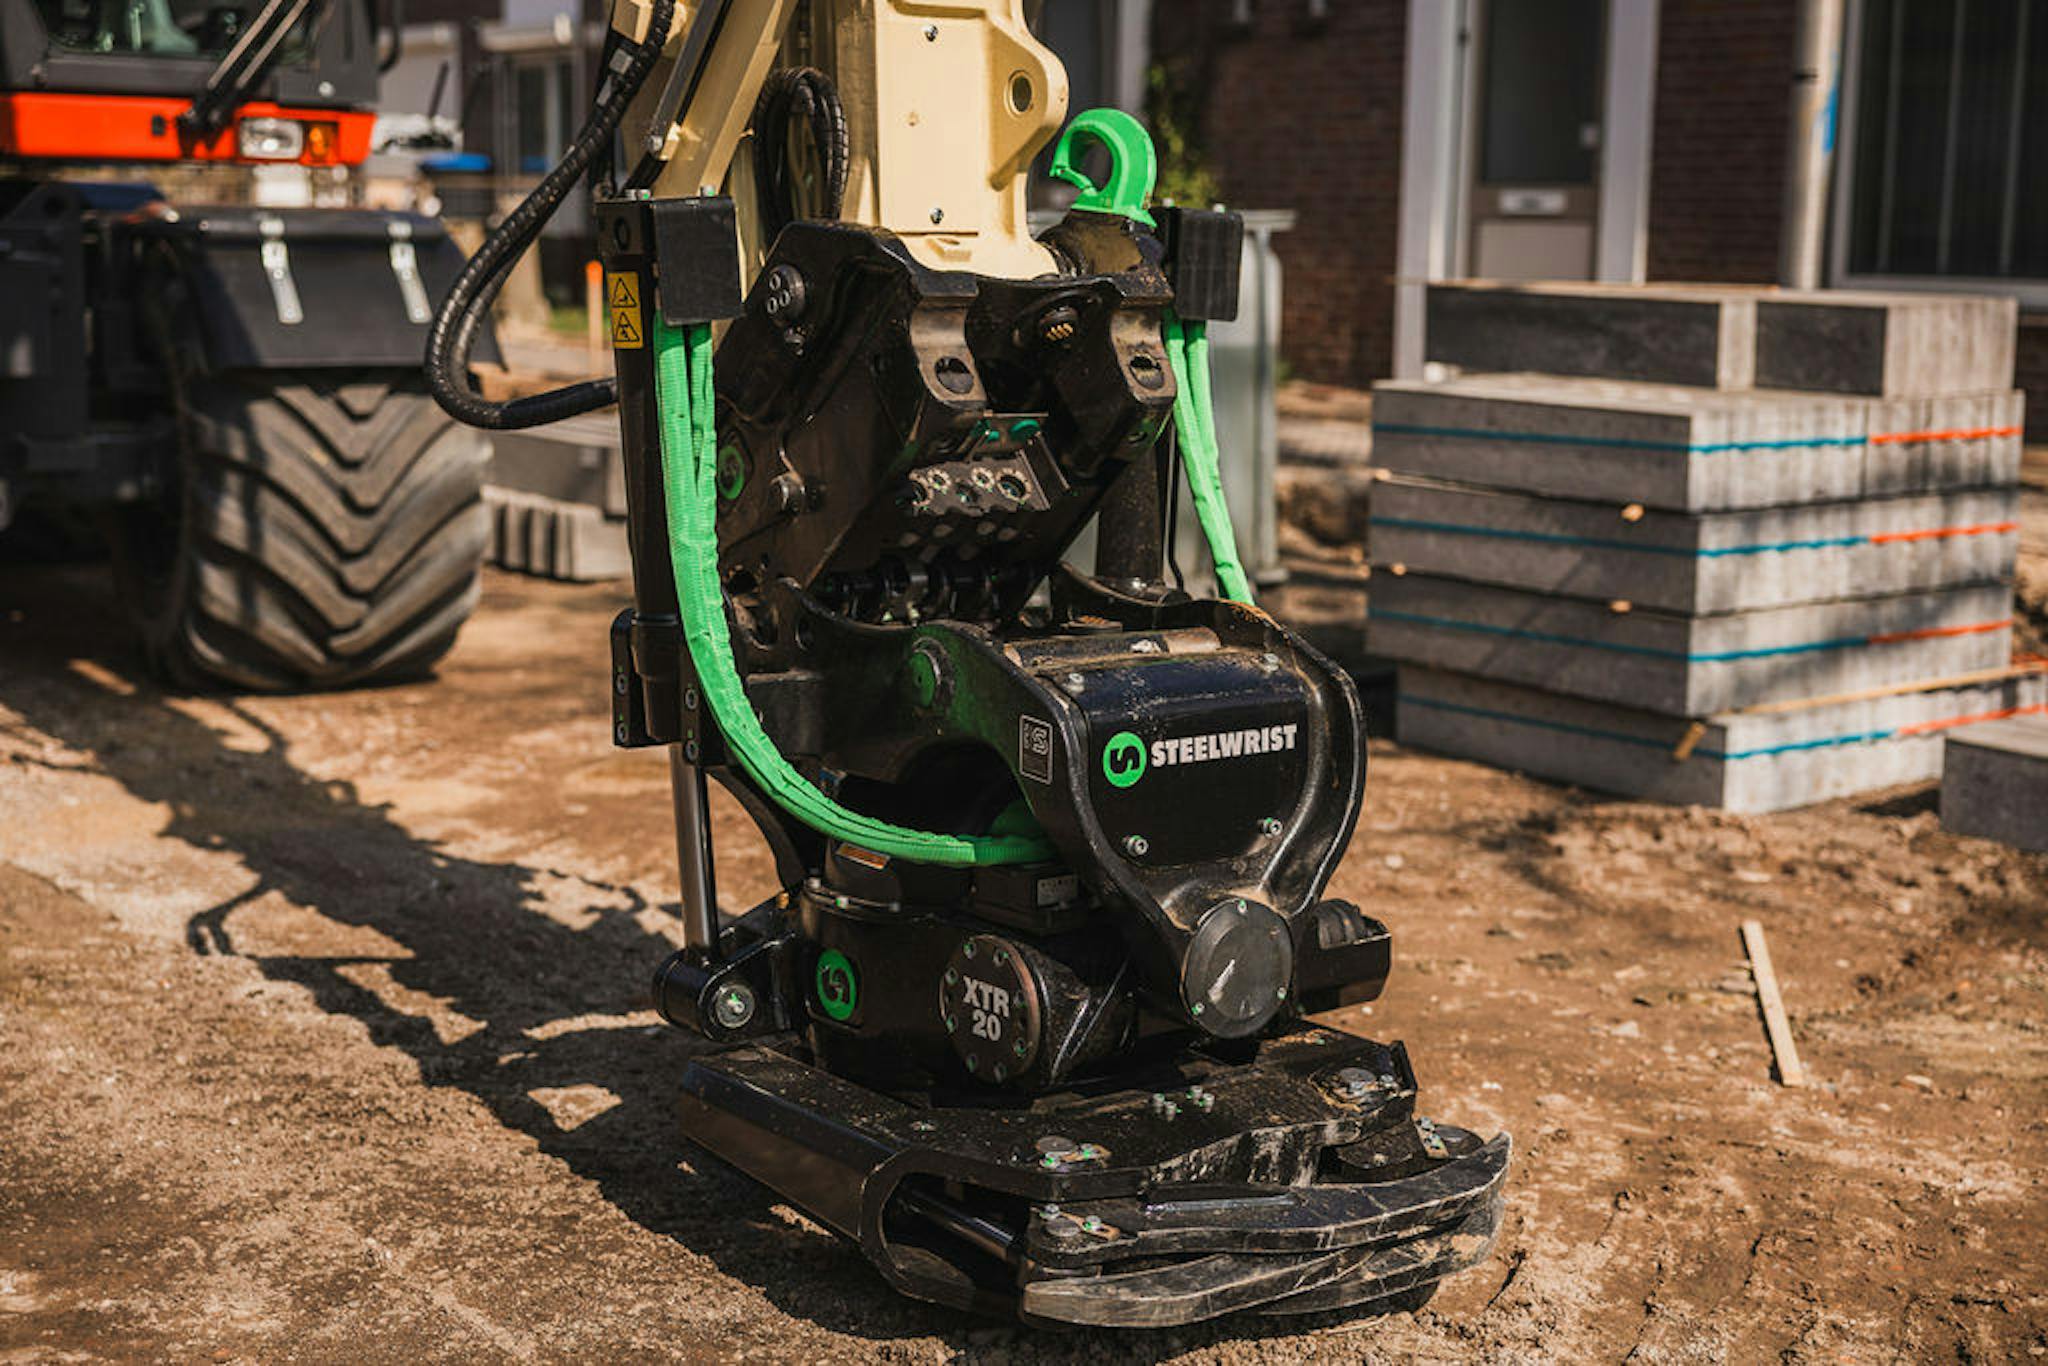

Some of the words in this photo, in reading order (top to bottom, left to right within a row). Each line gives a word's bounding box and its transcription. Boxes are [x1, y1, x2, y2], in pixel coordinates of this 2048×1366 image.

[1151, 723, 1298, 768] STEELWRIST
[963, 975, 1009, 1018] XTR
[972, 1009, 1001, 1041] 20
